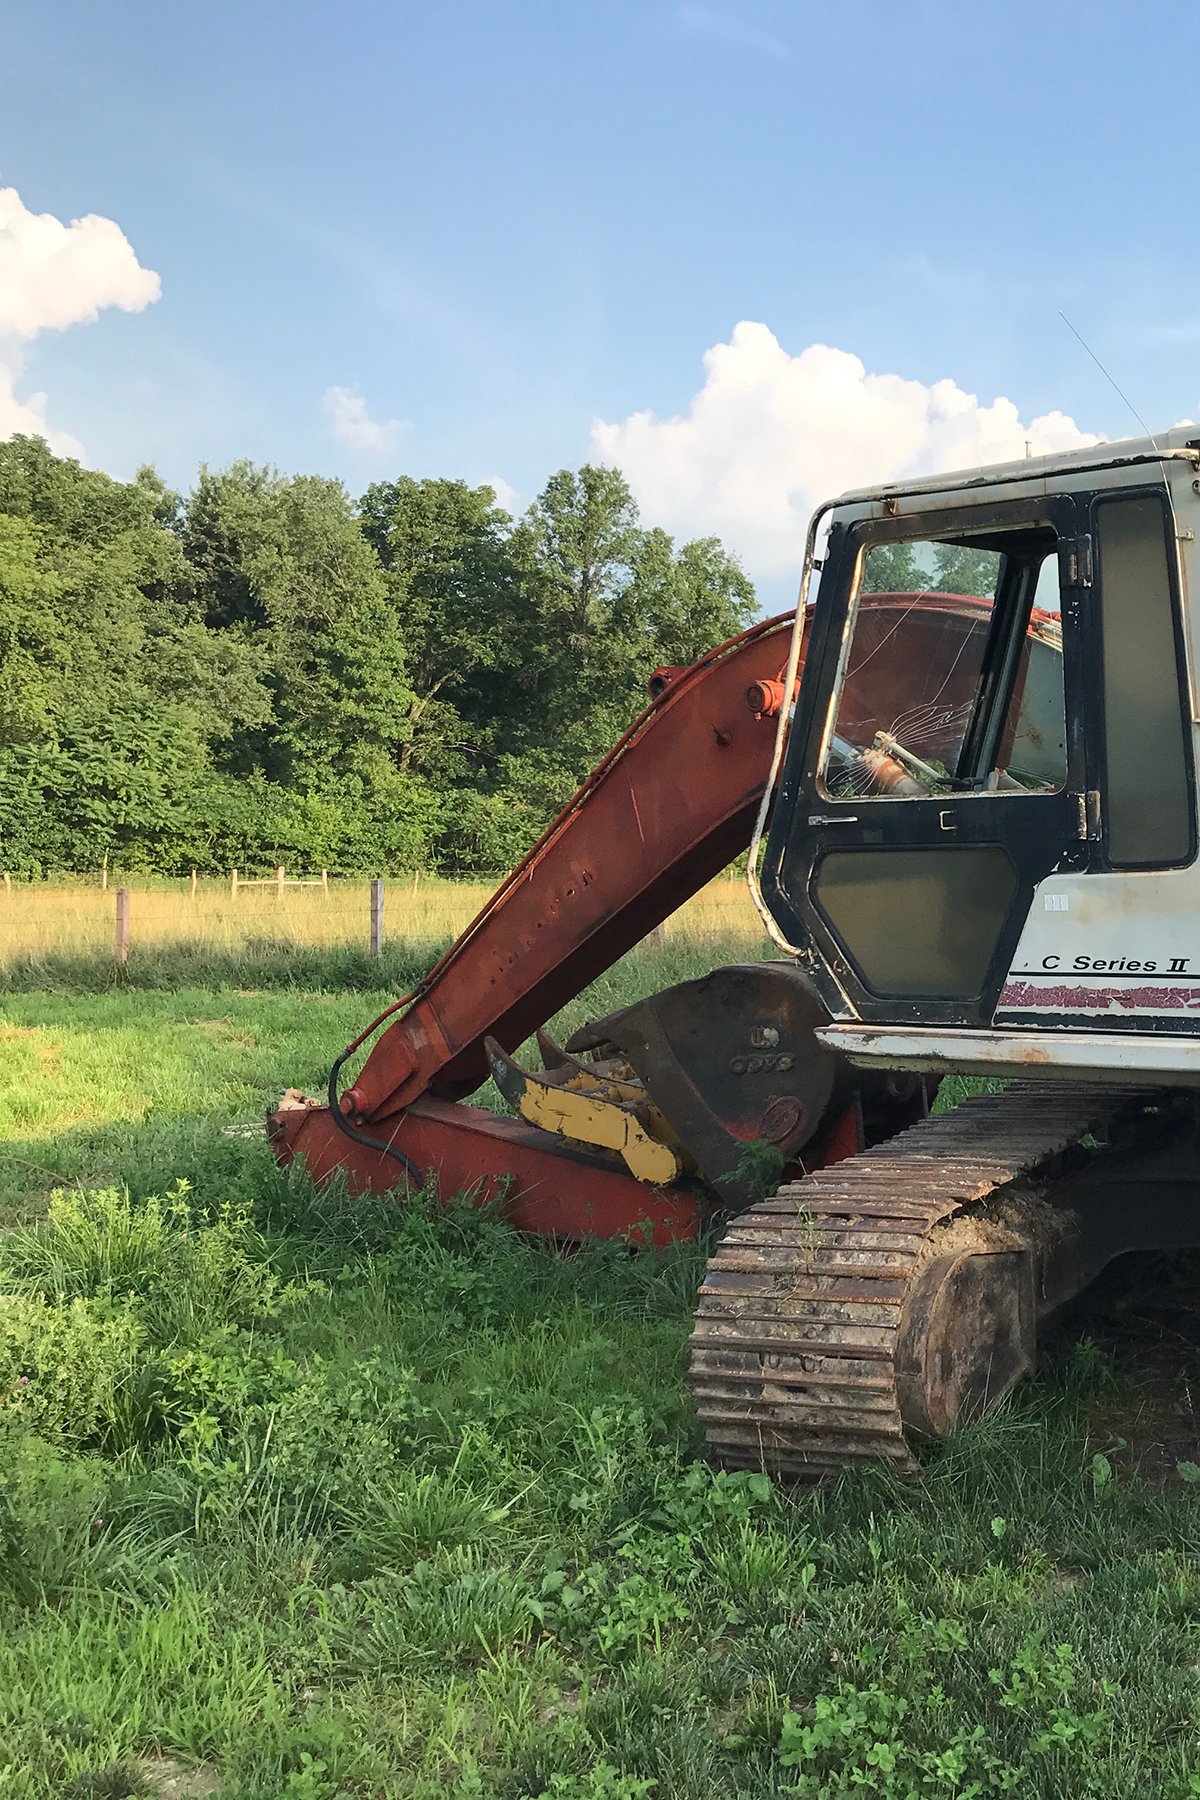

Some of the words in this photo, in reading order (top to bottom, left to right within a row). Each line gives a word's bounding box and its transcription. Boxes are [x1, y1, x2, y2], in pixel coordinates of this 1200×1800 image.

[1042, 955, 1061, 970] C
[1072, 955, 1158, 972] Series
[1166, 958, 1190, 973] II
